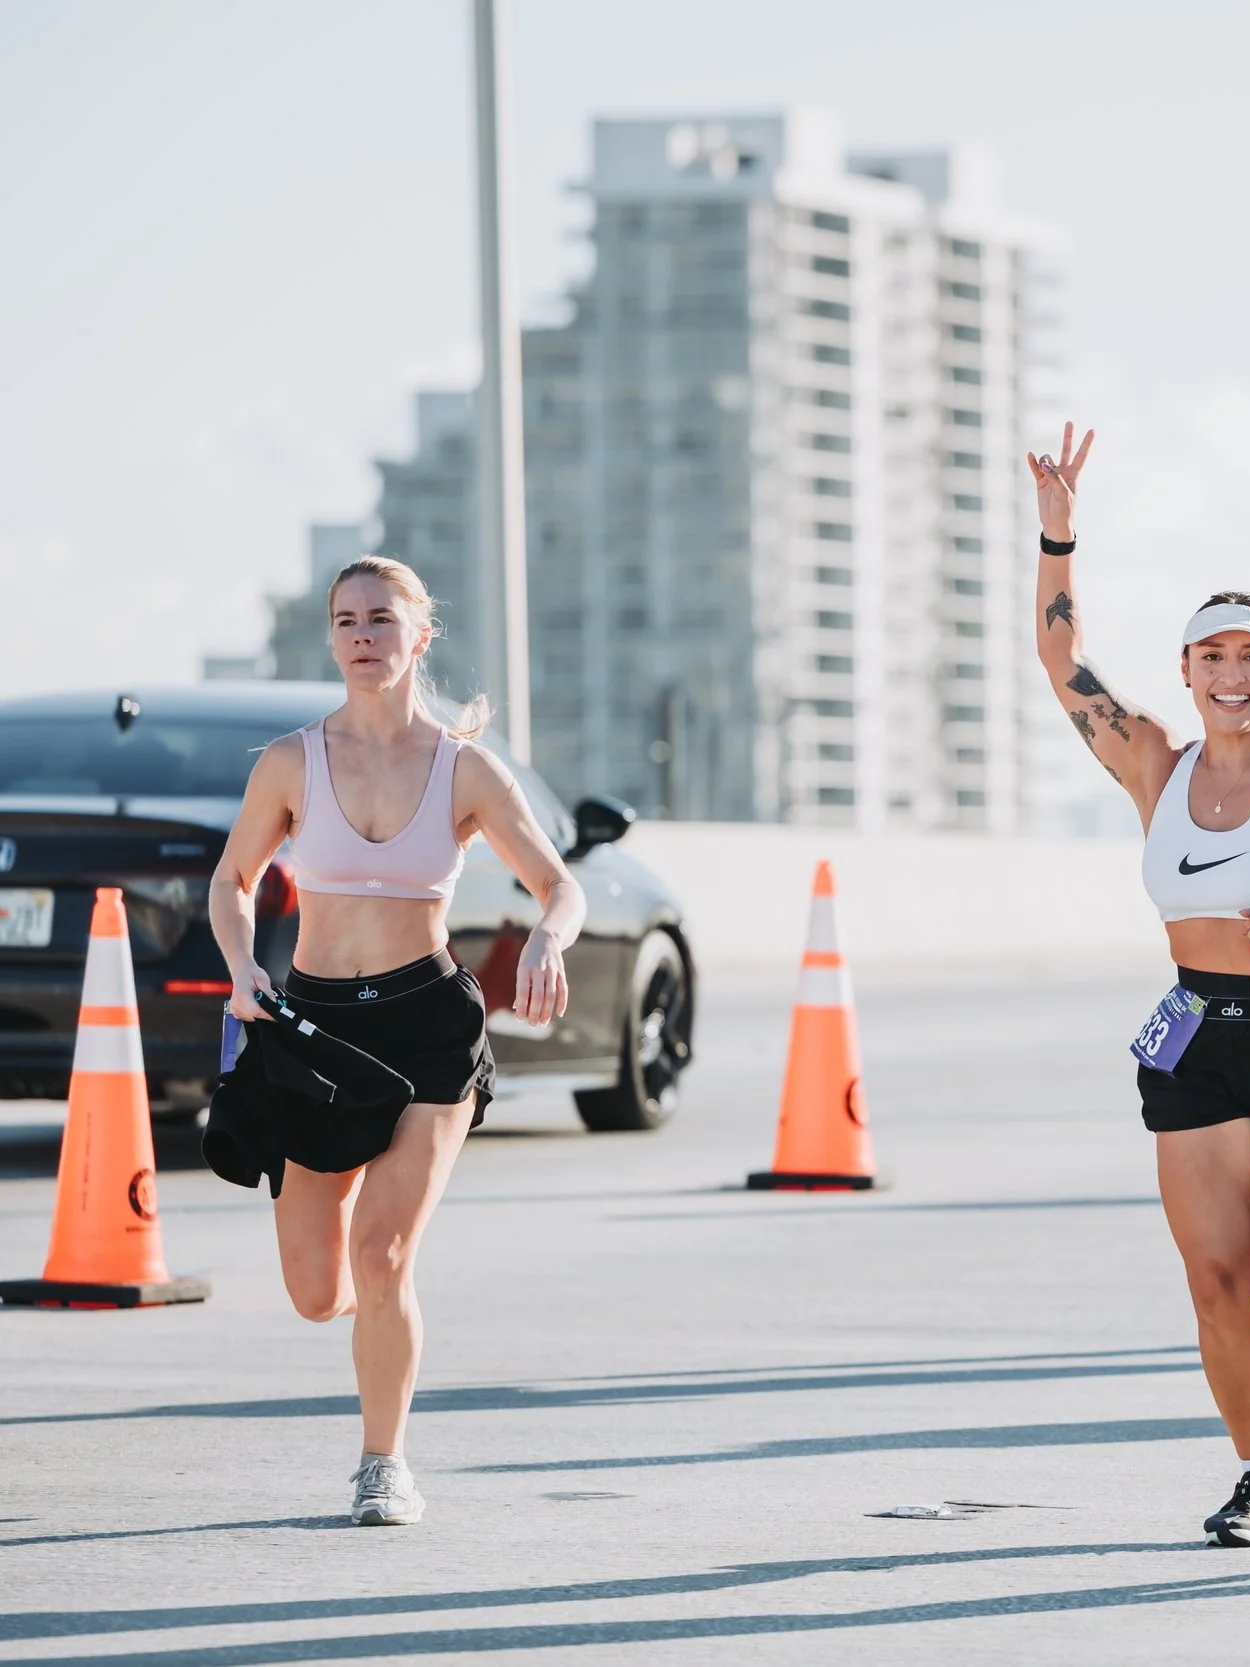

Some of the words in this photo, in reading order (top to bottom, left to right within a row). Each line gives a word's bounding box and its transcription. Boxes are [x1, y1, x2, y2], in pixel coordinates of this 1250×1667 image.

[367, 878, 382, 889] alo
[358, 985, 378, 999] alo
[1221, 1001, 1243, 1017] alo
